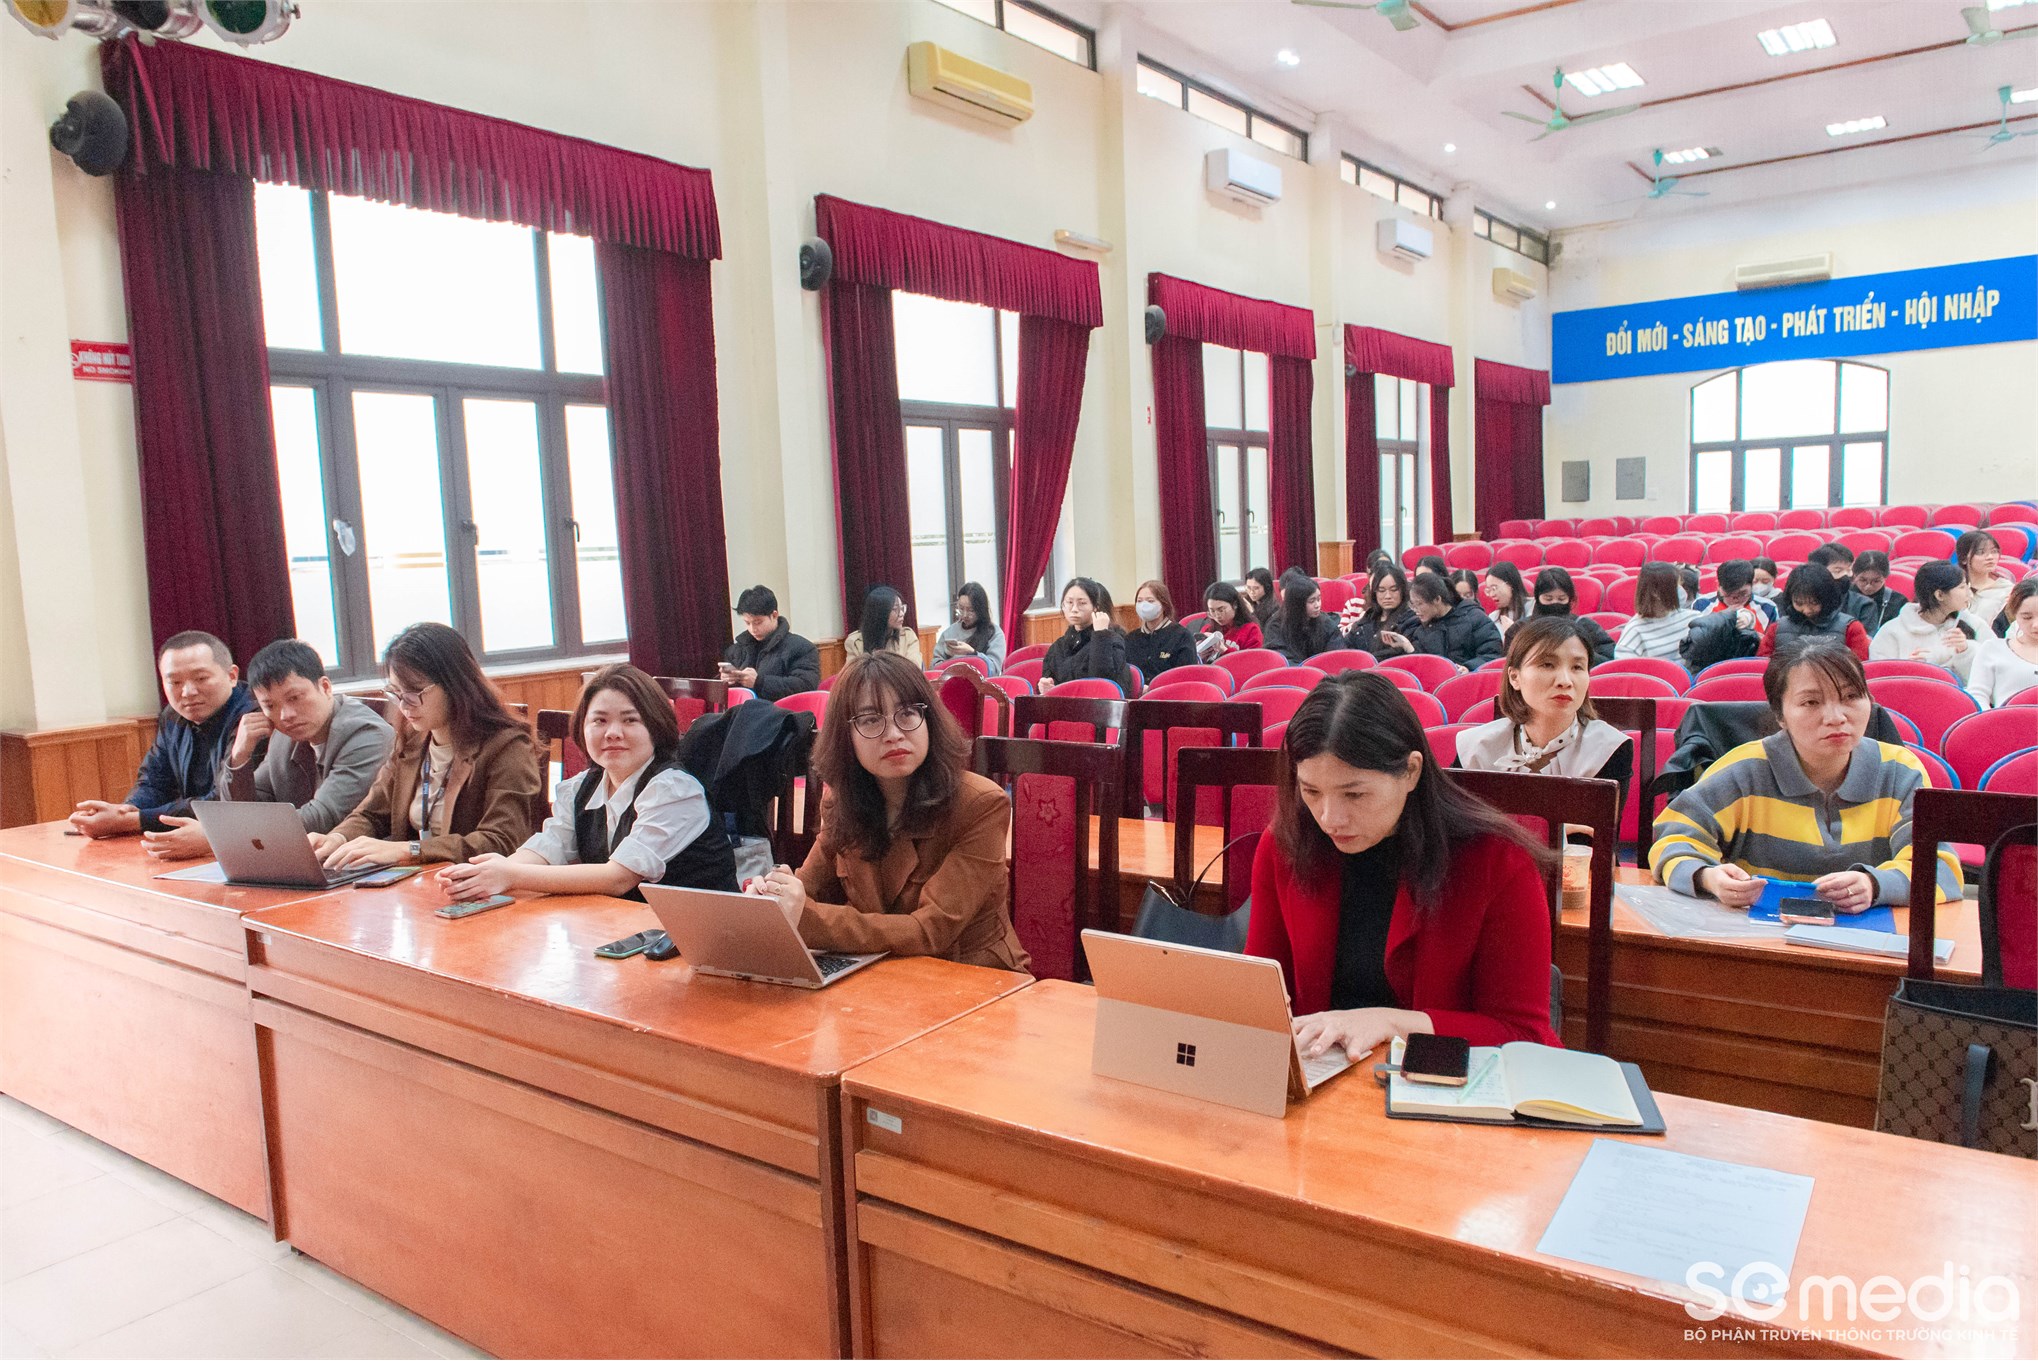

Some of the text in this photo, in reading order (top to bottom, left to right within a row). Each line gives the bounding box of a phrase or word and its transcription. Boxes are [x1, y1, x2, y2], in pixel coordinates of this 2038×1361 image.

[1606, 321, 1632, 356] ĐỔI
[1637, 321, 1668, 352] MỚI
[1683, 317, 1729, 348] SÁNG
[1734, 316, 1767, 346] TẠO
[1782, 304, 1828, 338] PHÁT
[1833, 291, 1887, 333] TRIỂN
[1905, 291, 1938, 329] HỘI
[1944, 285, 2000, 324] NHẬP
